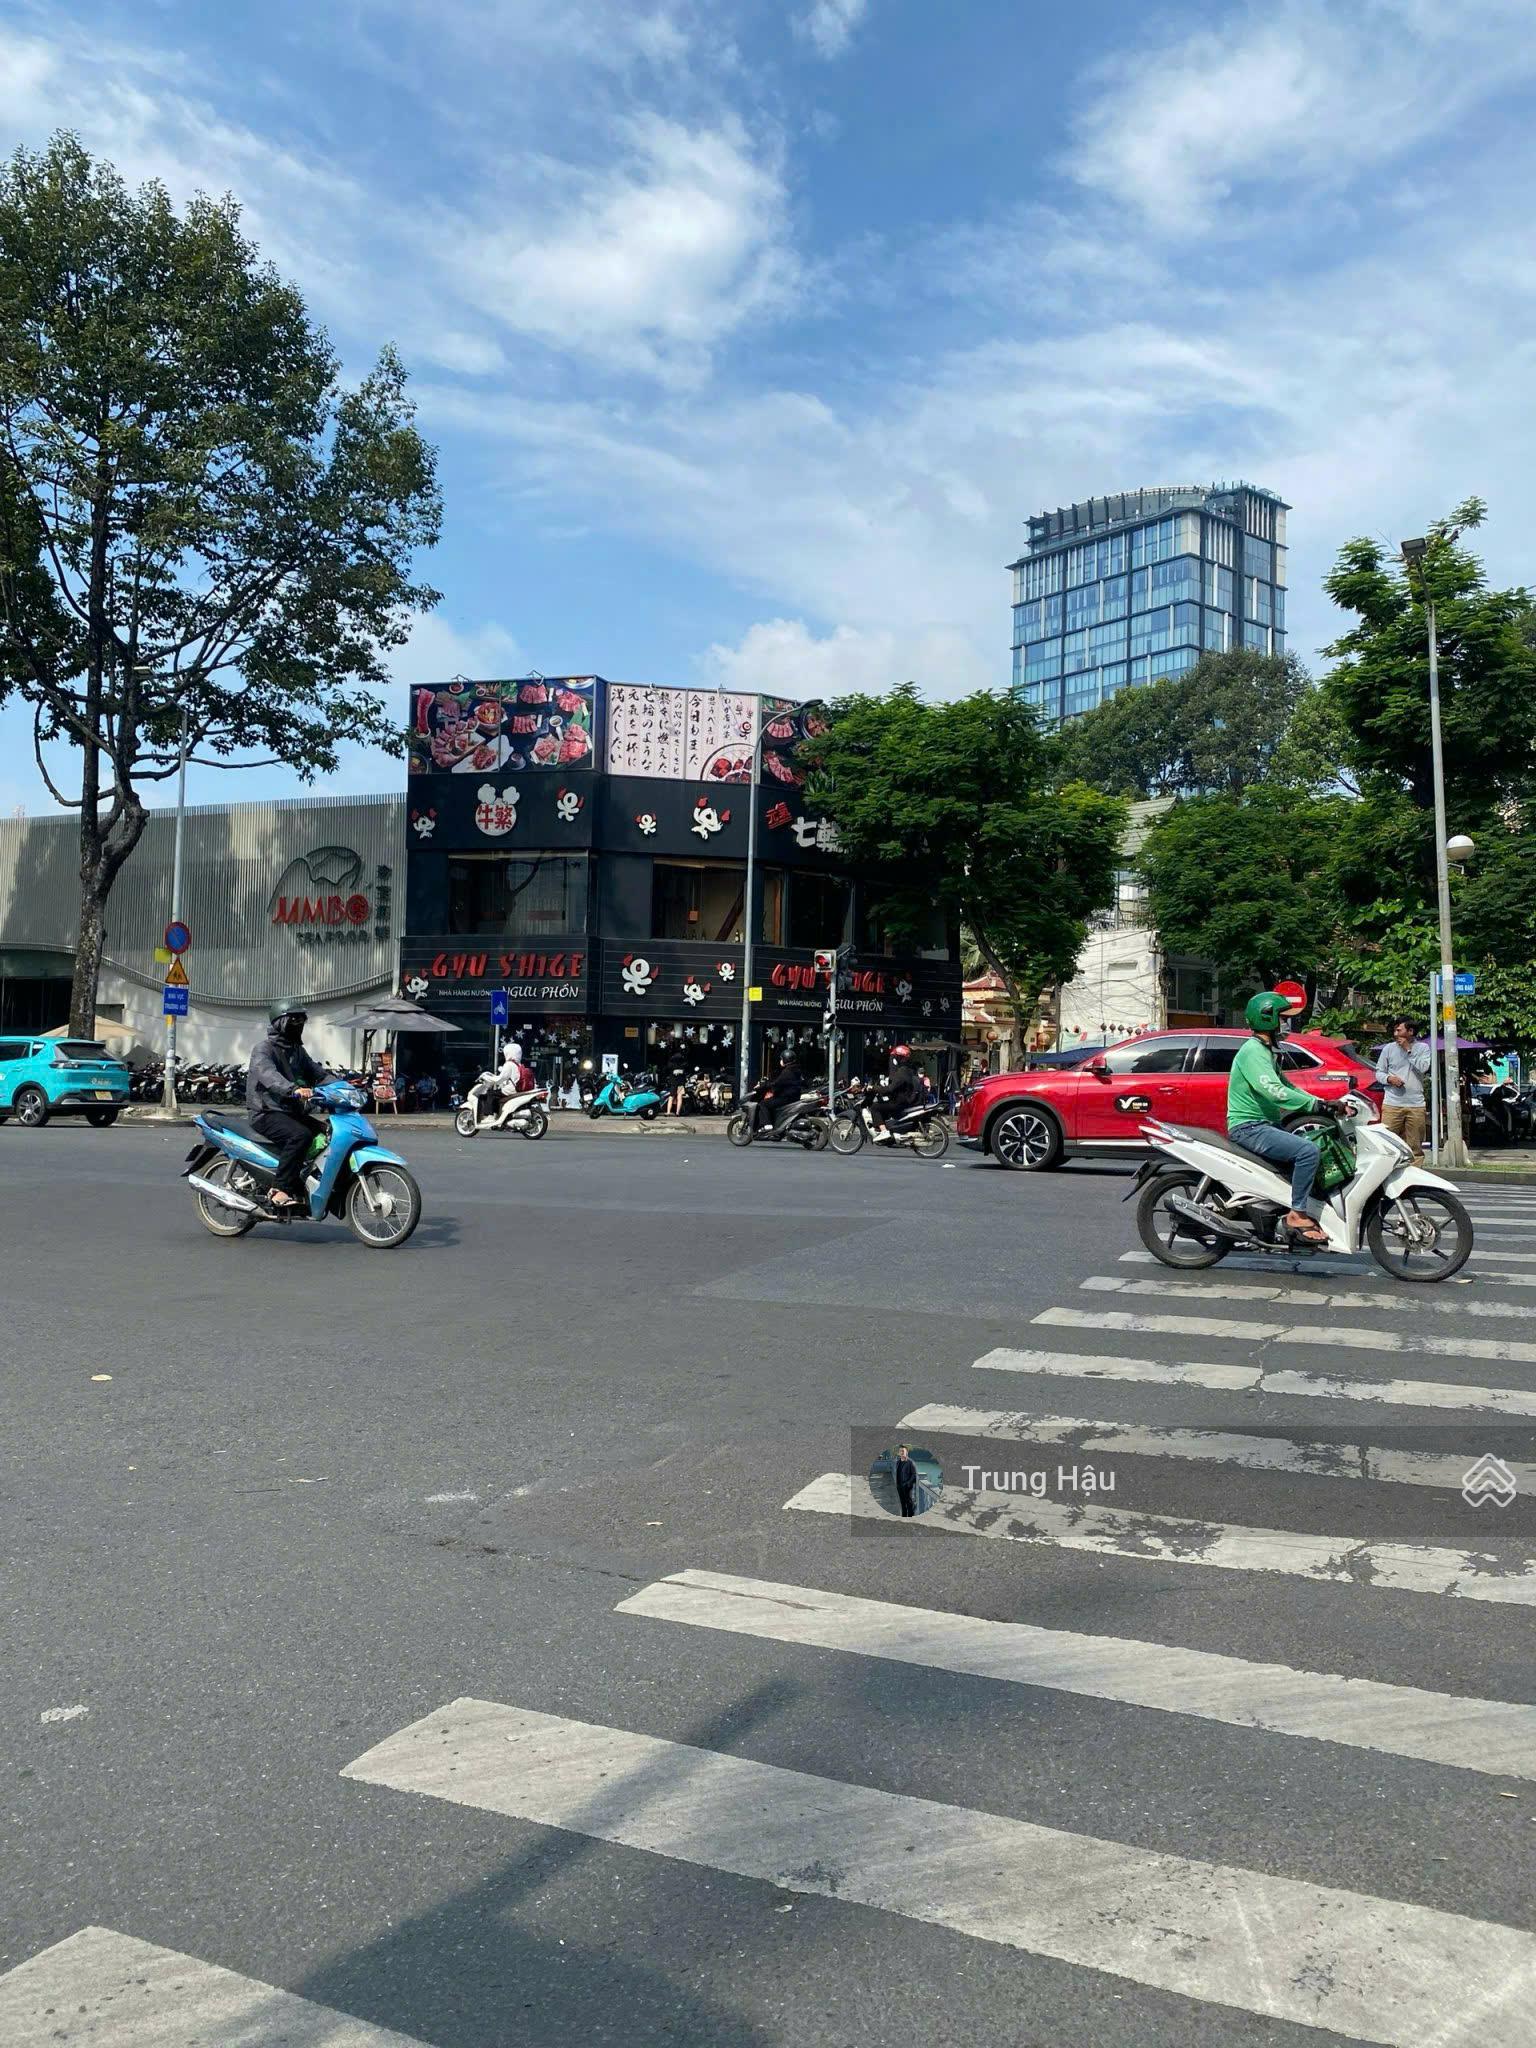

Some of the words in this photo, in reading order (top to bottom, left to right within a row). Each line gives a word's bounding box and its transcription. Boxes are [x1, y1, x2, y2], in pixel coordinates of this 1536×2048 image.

[271, 894, 370, 925] JUMBO
[432, 953, 488, 979] GYU
[500, 953, 585, 978] SHIGE
[772, 963, 817, 990] GYU
